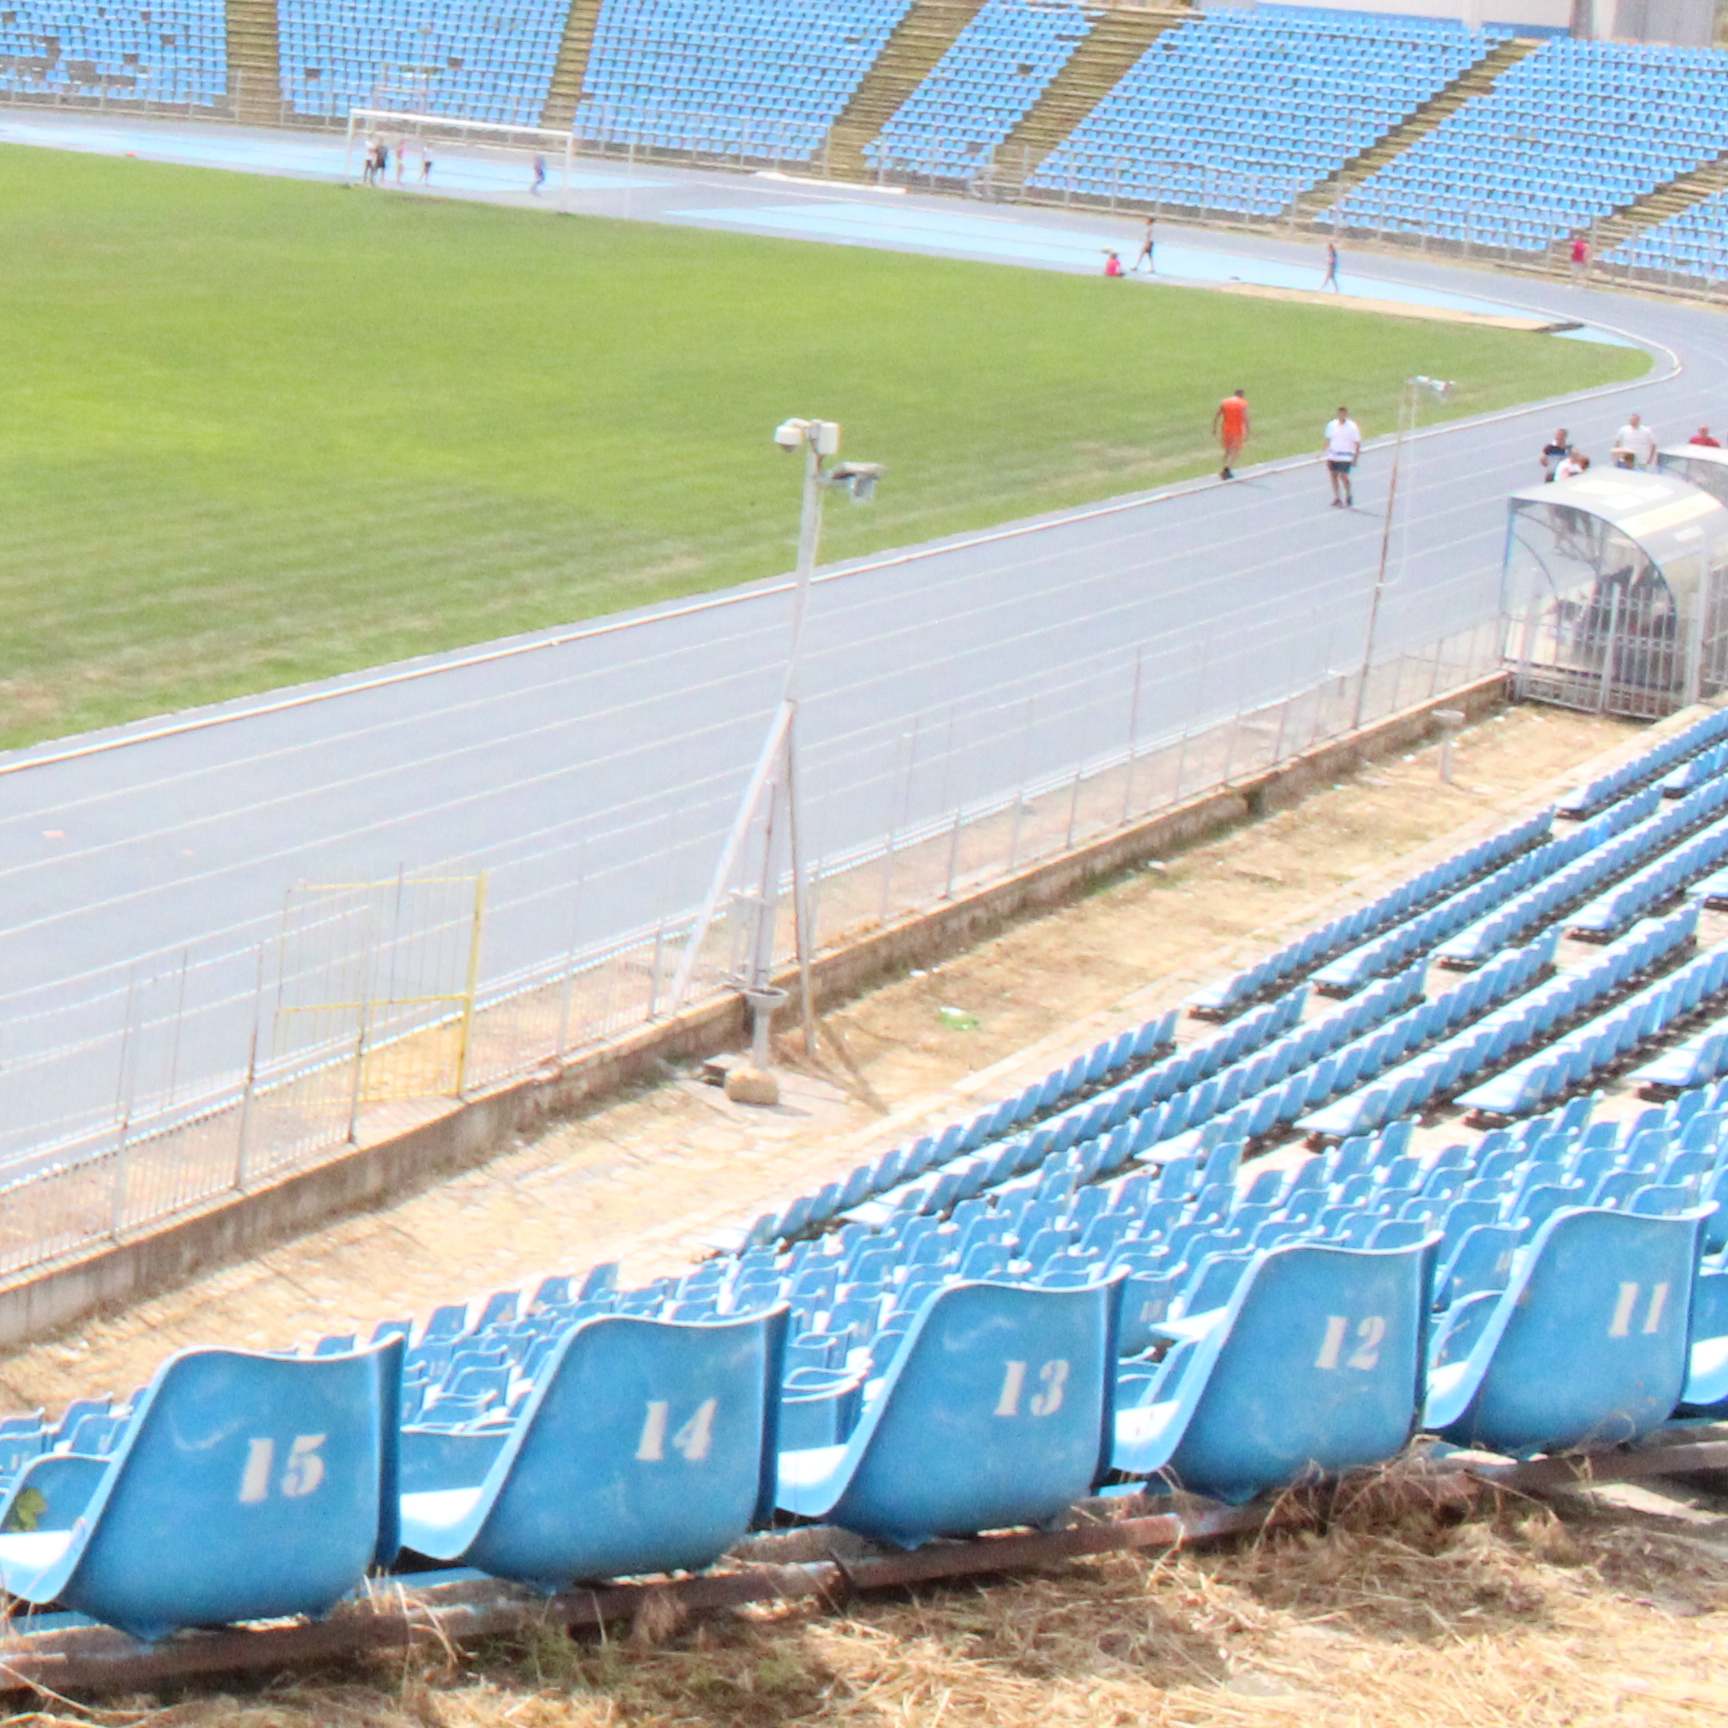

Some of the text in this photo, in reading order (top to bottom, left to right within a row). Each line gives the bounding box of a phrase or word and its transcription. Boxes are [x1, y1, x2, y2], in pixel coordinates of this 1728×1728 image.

[1607, 1280, 1671, 1338] 11
[1314, 1314, 1388, 1371] 12
[993, 1358, 1072, 1418] 13
[635, 1397, 718, 1462] 14
[237, 1432, 329, 1505] 15
